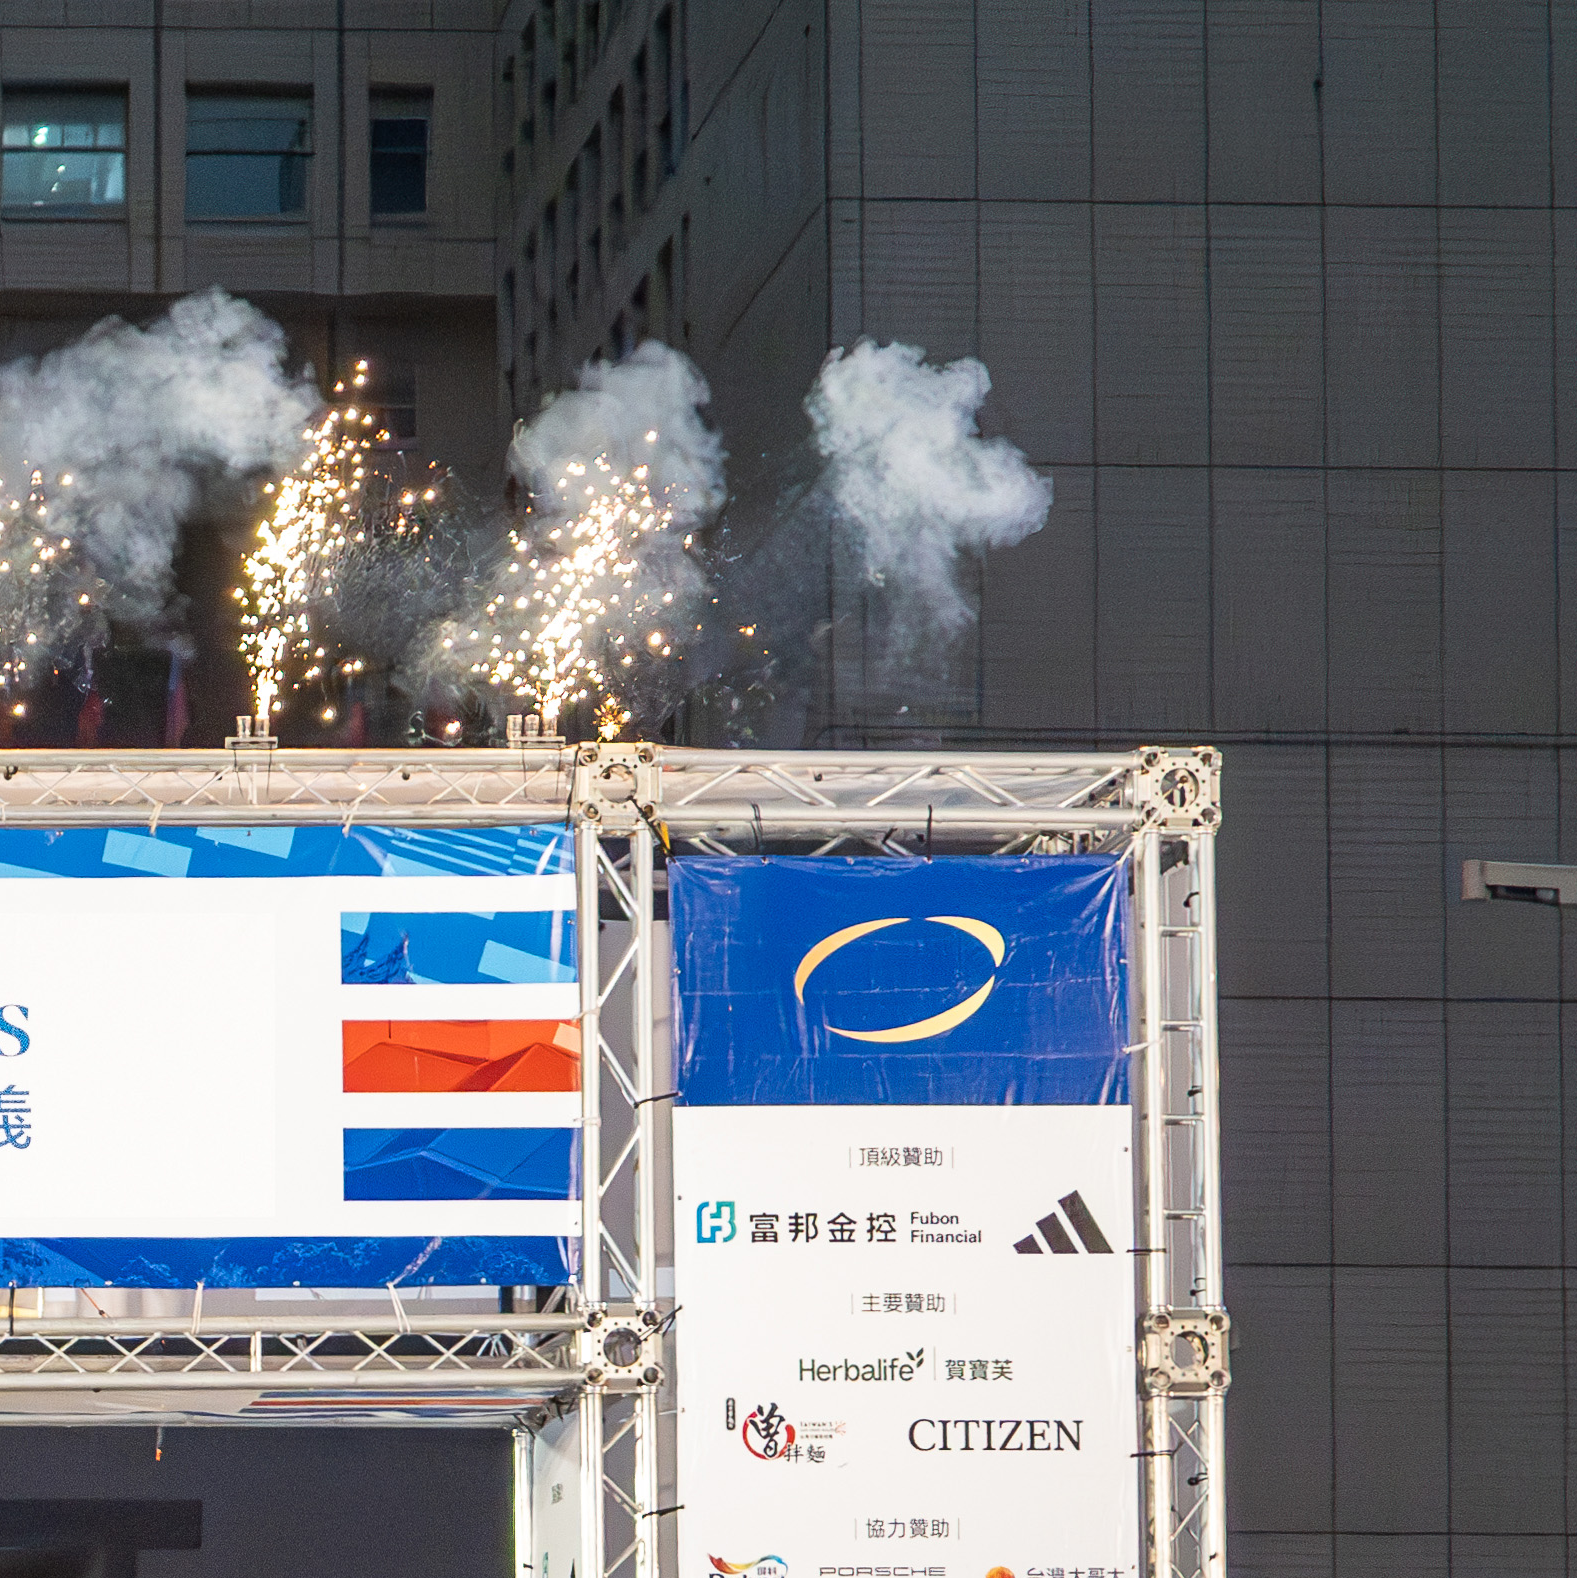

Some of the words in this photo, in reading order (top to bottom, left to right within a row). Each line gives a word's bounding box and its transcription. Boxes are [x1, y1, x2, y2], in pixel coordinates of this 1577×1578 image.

[748, 1212, 897, 1244] 富邦金控
[910, 1211, 960, 1226] Fubon
[910, 1228, 983, 1244] Financial
[799, 1358, 914, 1382] Herbalife
[945, 1359, 1014, 1382] 賀寶芙
[908, 1418, 1085, 1452] CITIZEN
[818, 1566, 947, 1577] PORSCHE
